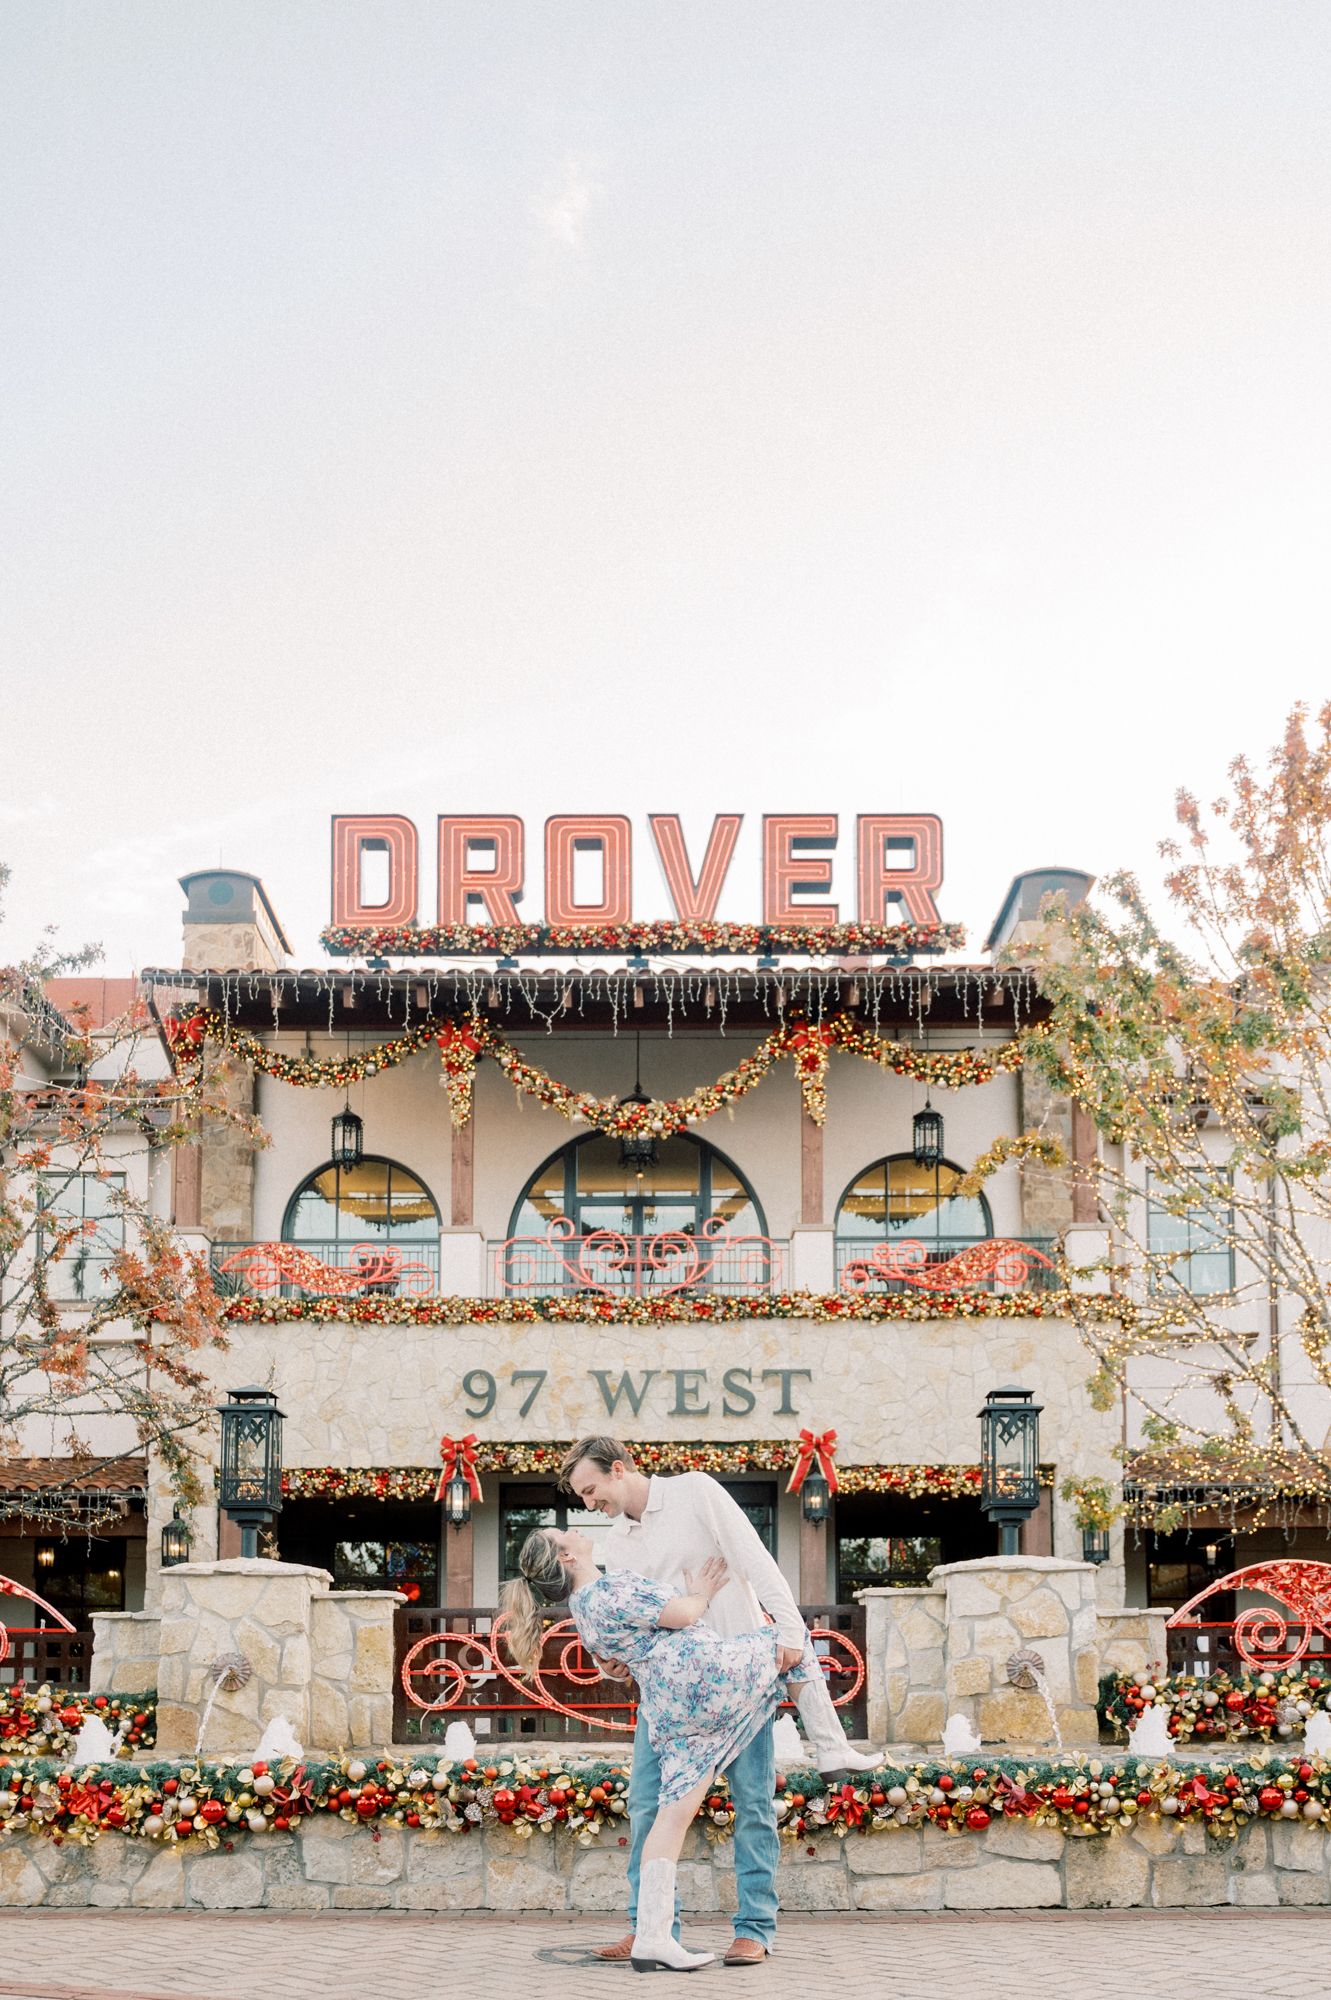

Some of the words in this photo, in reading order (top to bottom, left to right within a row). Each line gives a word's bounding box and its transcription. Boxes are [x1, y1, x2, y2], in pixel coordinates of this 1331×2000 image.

[331, 813, 944, 927] DROVER
[462, 1369, 548, 1419] 97
[587, 1367, 812, 1418] WEST
